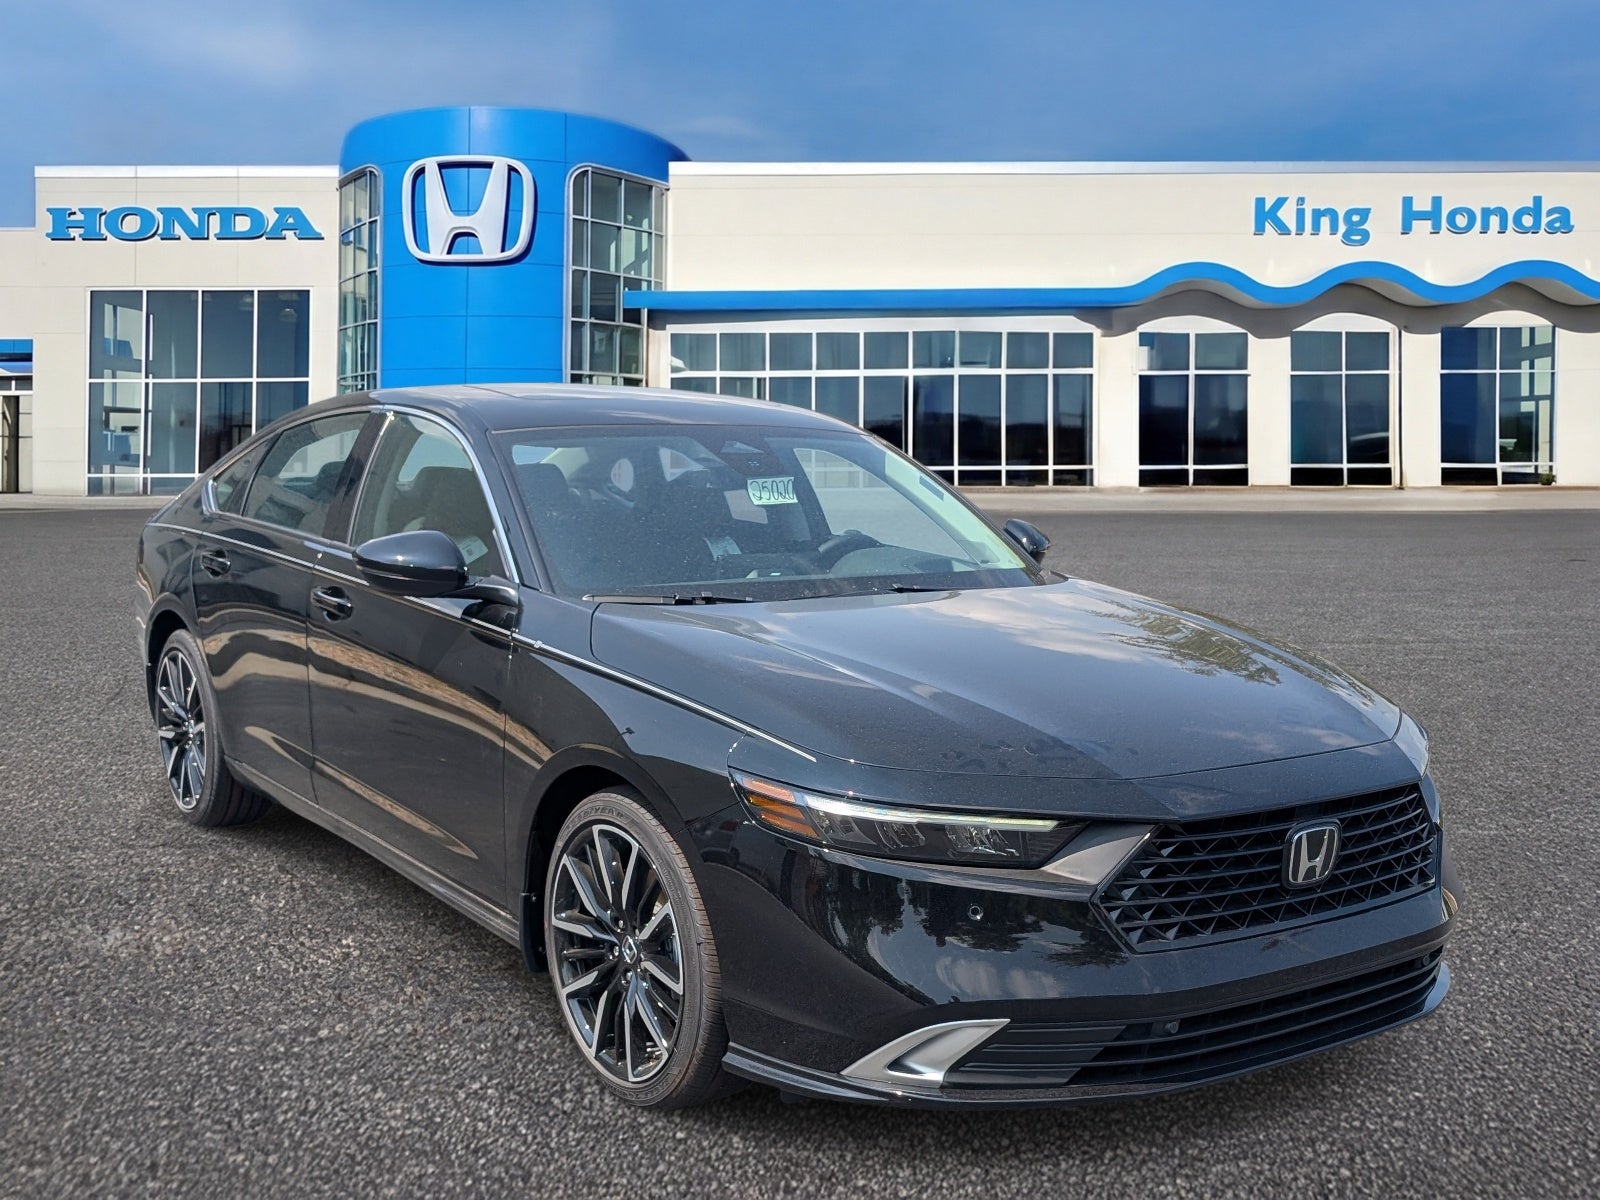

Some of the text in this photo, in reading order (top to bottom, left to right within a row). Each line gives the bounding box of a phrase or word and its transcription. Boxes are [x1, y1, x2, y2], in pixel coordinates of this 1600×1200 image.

[46, 206, 324, 241] HONDA
[1253, 195, 1575, 246] King Honda
